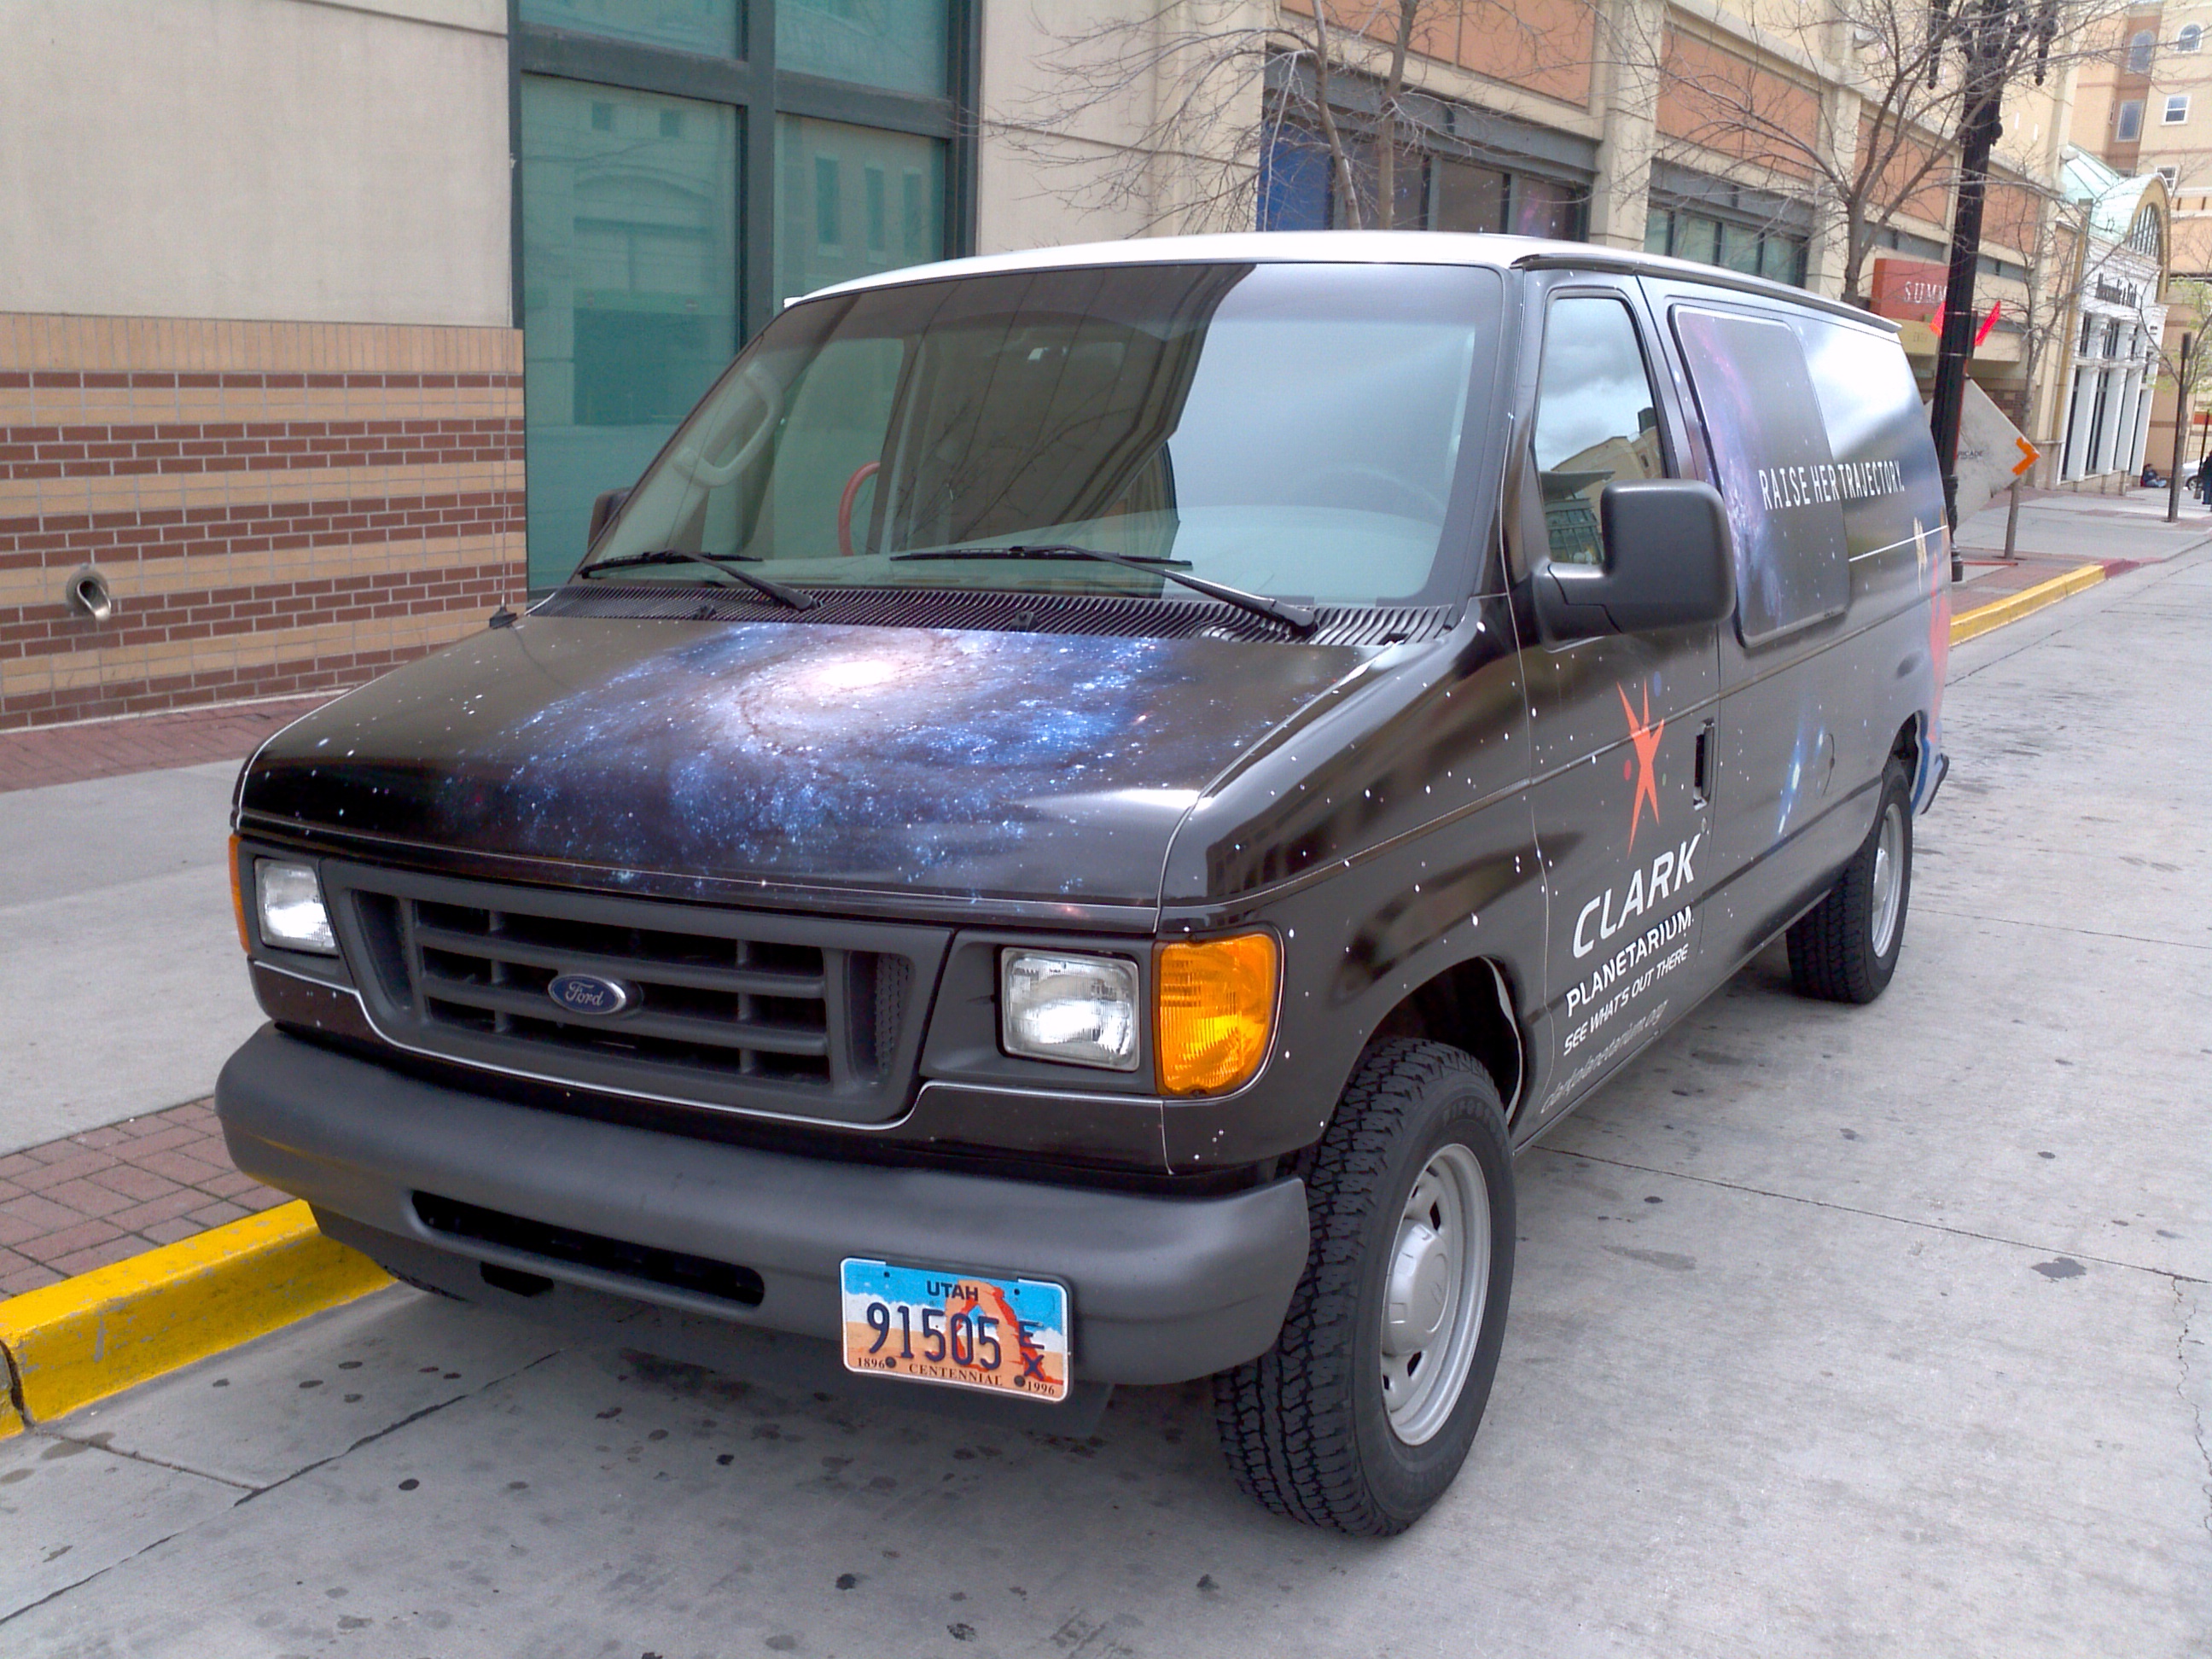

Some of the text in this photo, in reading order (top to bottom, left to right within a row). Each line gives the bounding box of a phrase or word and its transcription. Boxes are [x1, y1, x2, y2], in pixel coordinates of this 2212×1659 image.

[1758, 467, 1810, 510] RAISE
[1810, 463, 1840, 504] HER
[1572, 832, 1702, 959] CLARK
[1566, 905, 1692, 1018] PLANETARIUM
[565, 981, 604, 1006] Ford
[1563, 1021, 1588, 1057] SEE
[1631, 968, 1655, 998] OUT
[1656, 943, 1689, 980] THERE
[927, 1280, 979, 1301] UTAH
[866, 1301, 1001, 1370] 91505
[857, 1356, 886, 1369] 1896
[908, 1363, 1003, 1387] CENTENNIAL
[1026, 1380, 1055, 1395] 1996
